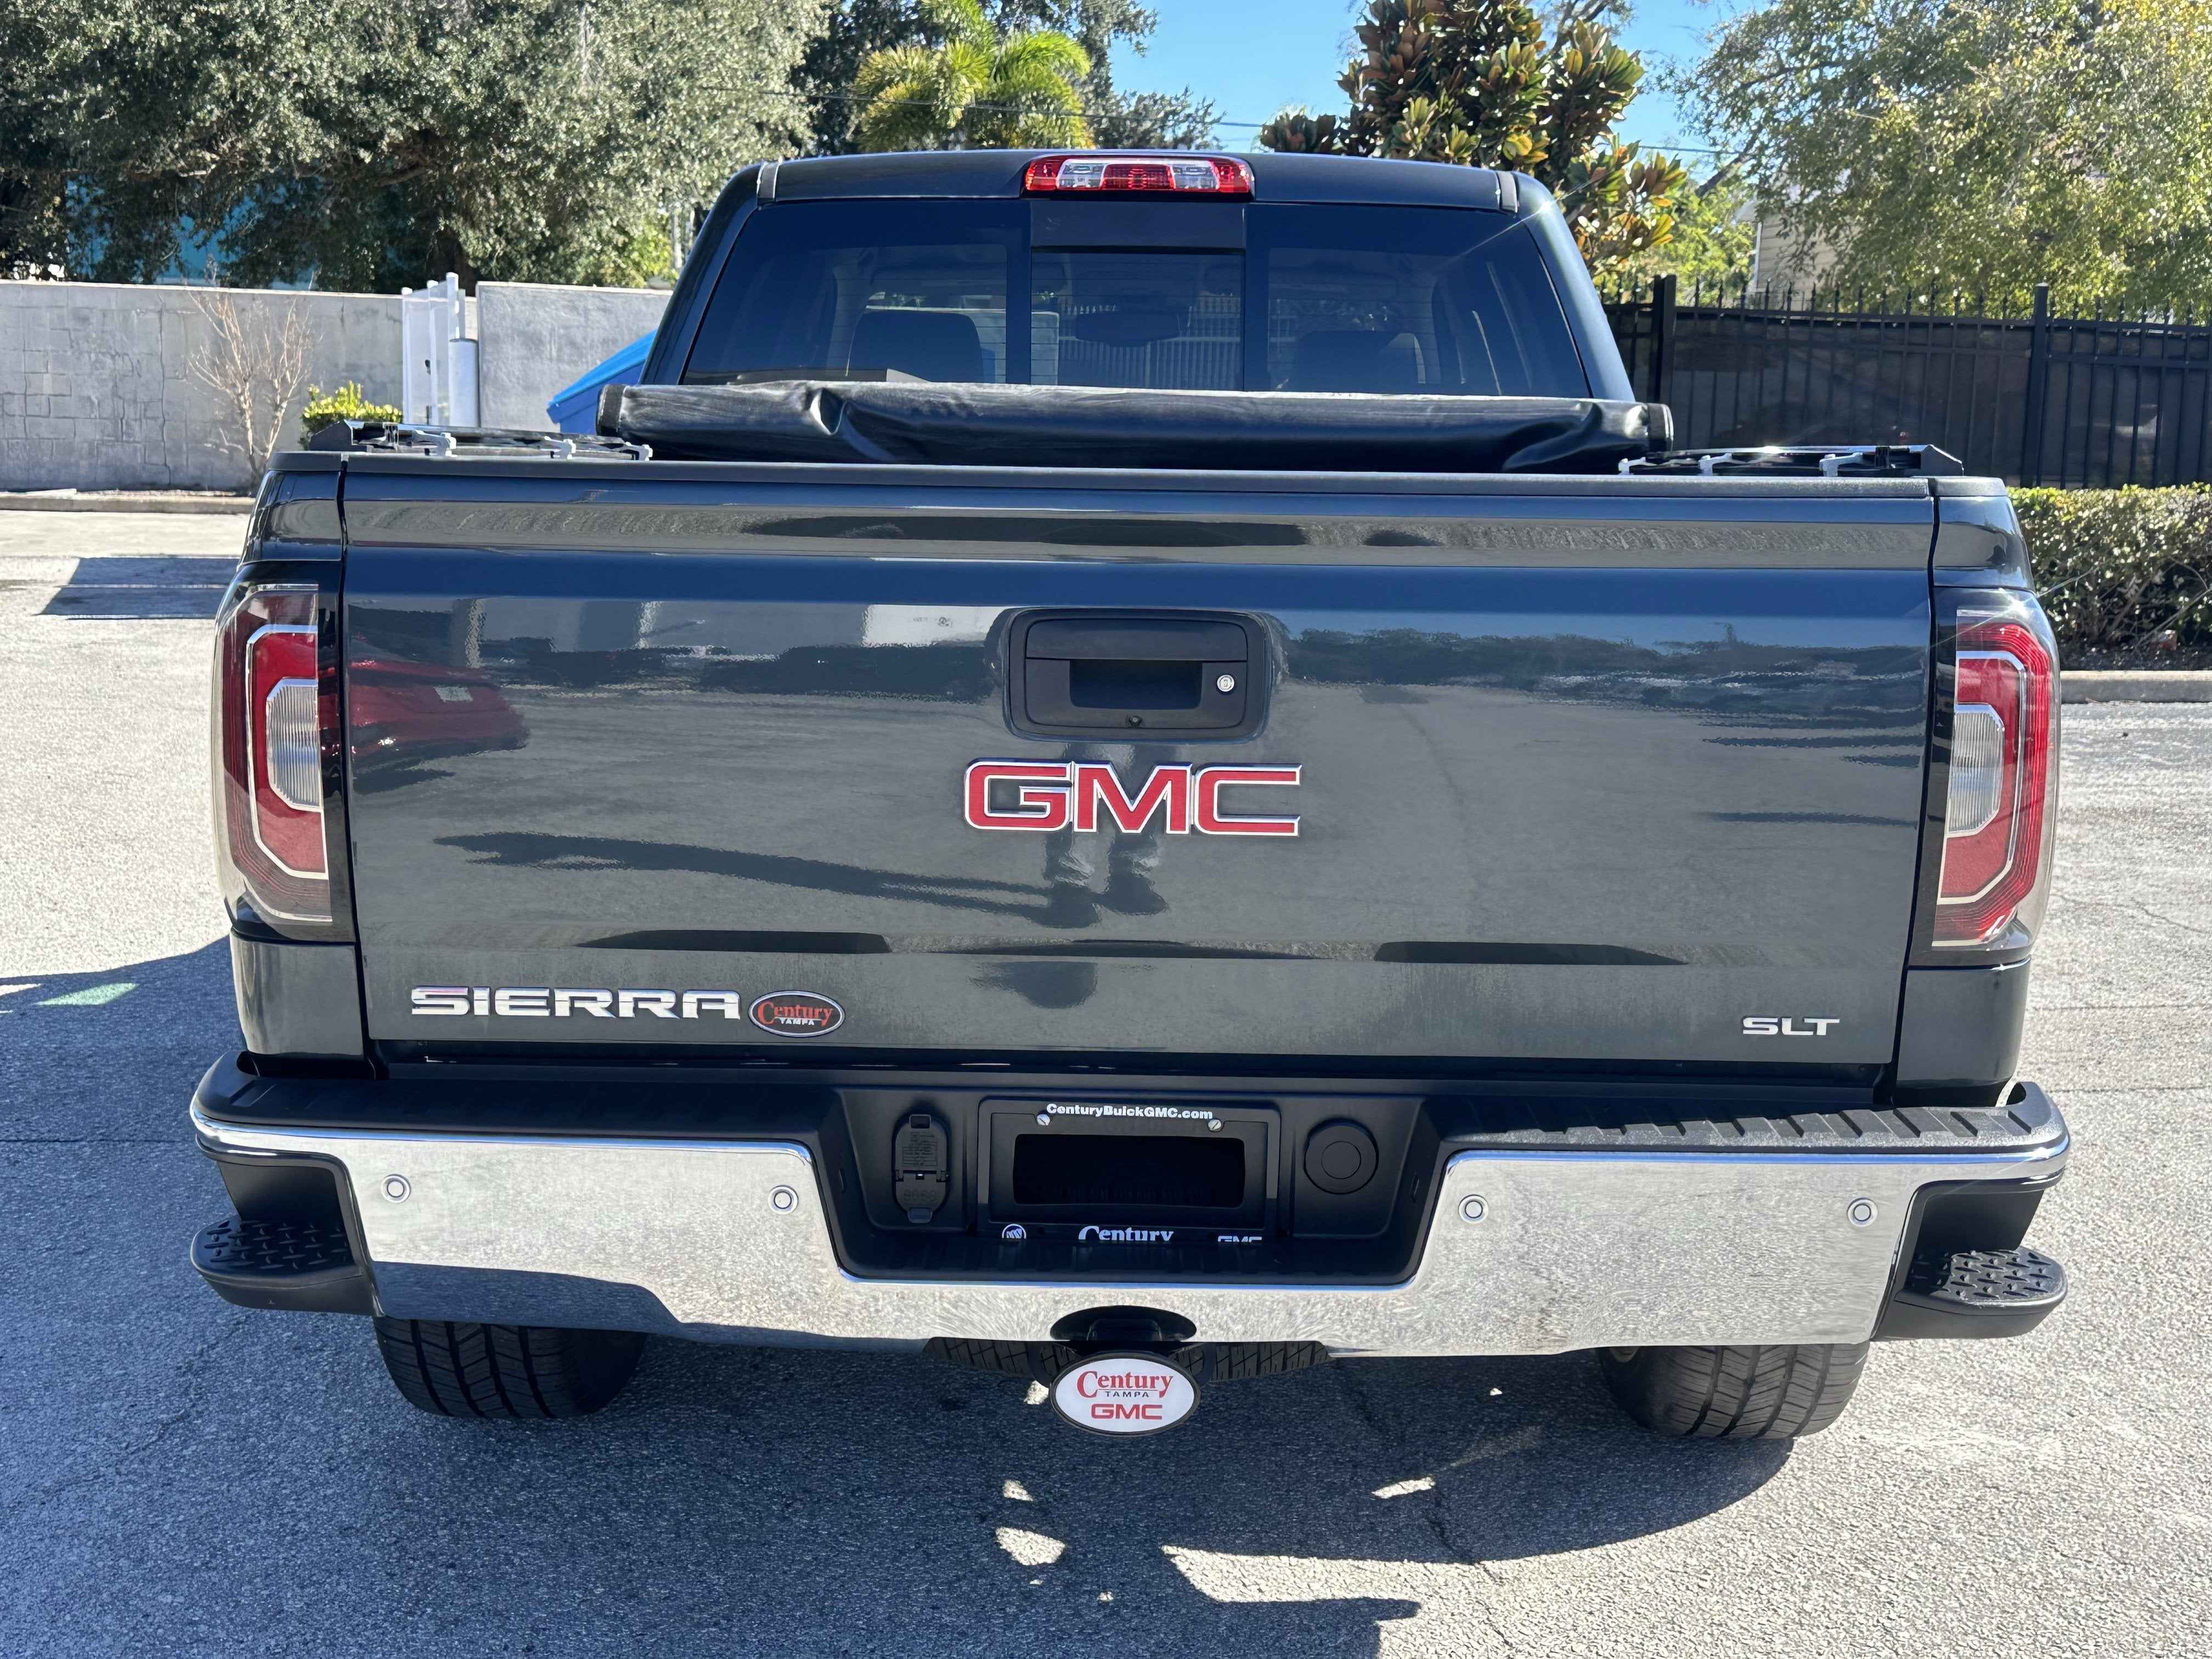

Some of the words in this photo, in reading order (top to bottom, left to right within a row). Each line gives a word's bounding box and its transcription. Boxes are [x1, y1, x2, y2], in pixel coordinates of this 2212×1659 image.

[963, 758, 1302, 836] GMC
[410, 985, 741, 1019] SIERRA
[758, 996, 833, 1026] Century
[1742, 1015, 1841, 1036] SLT
[1046, 1103, 1213, 1119] CenturyBuickGMC.com
[1077, 1371, 1174, 1398] Century
[1091, 1403, 1163, 1420] GMC
